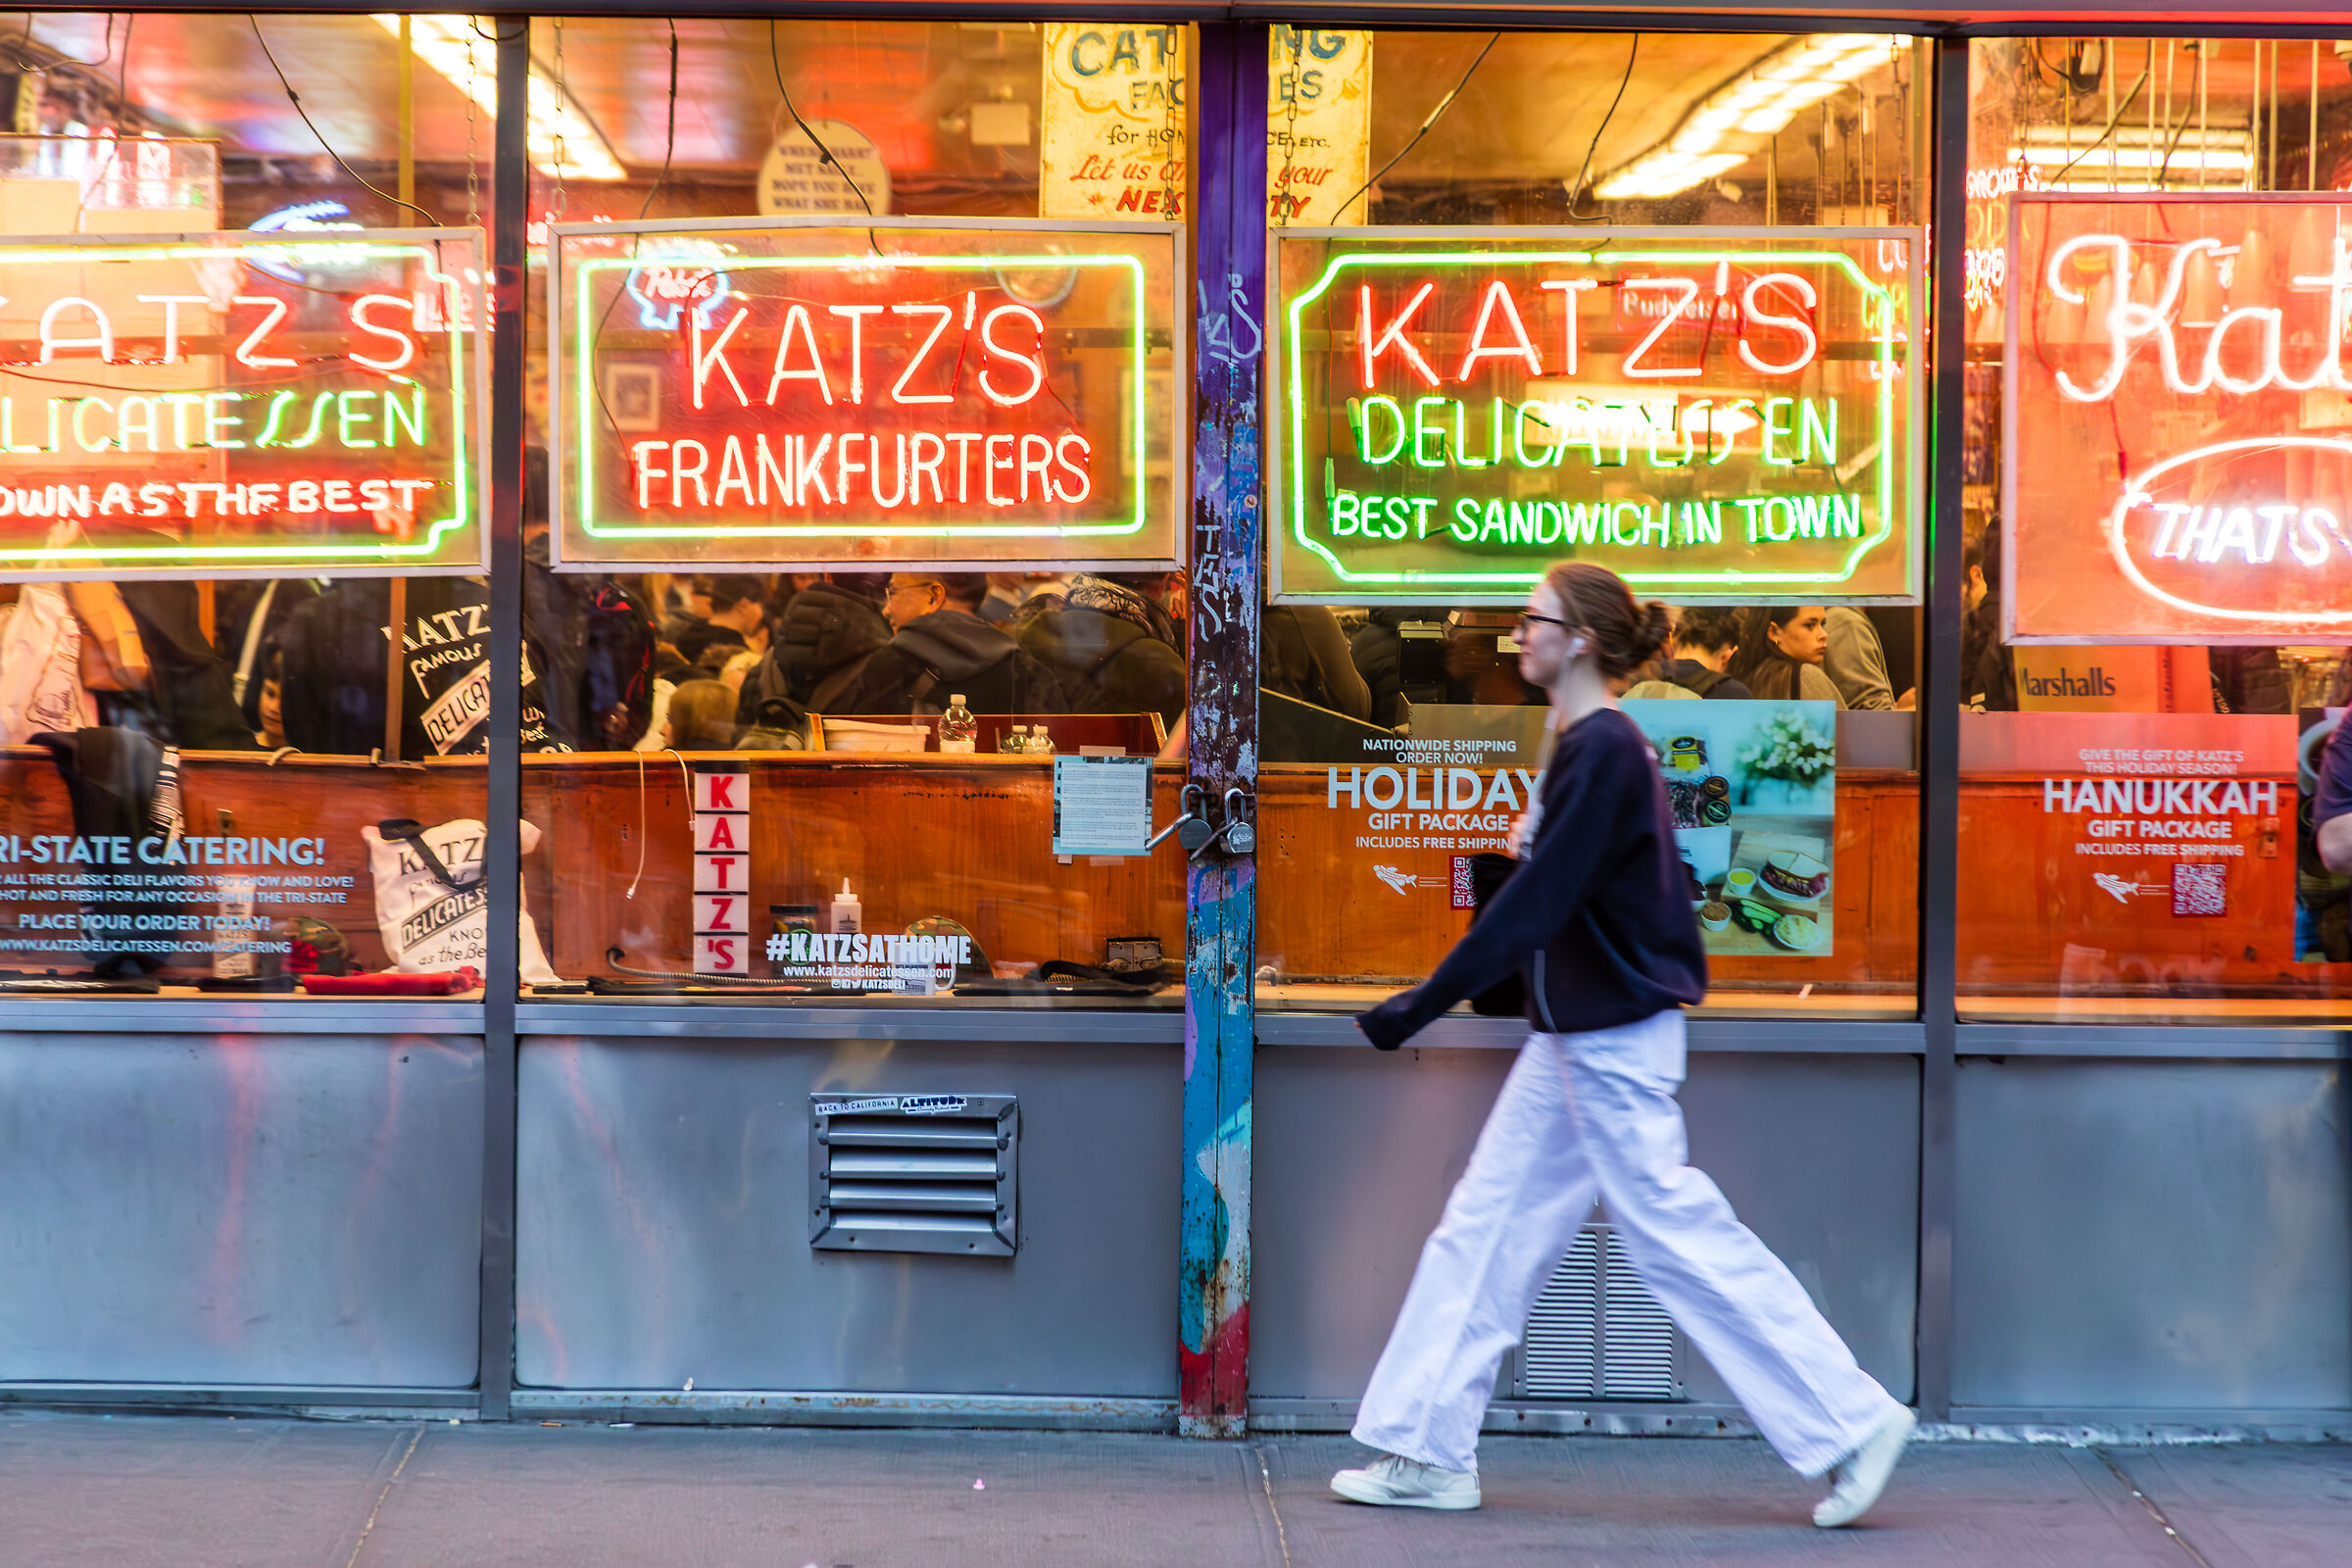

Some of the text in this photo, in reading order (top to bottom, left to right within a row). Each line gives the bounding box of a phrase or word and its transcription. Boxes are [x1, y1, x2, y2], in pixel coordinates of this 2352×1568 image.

[1107, 125, 1139, 145] for
[1070, 154, 1115, 181] Let
[1123, 162, 1152, 180] us
[1274, 166, 1334, 189] your
[1116, 186, 1185, 215] NEX
[0, 294, 414, 370] ATZS
[1359, 260, 1818, 389] KATZ'S
[690, 291, 1045, 409] KATZ'S
[1360, 395, 1838, 468] DELICATESSEN
[633, 432, 1092, 509] FRANKFURTERS
[288, 479, 434, 514] BEST
[1332, 493, 1861, 548] BEST SANDWICH IN TOWN
[1362, 739, 1517, 753] NATIONWIDE SHIPPING
[1396, 752, 1483, 764] ORDER NOW!
[2079, 749, 2244, 762] GIVE THE GIFT OF KATZ'S
[2085, 761, 2237, 774] THIS HOLIDAY SEASON!
[1328, 766, 1547, 811] HOLIDAY
[2043, 778, 2278, 815] HANUKKAH
[1368, 813, 1510, 831] GIFT PACKAGE
[2087, 819, 2232, 839] GIFT PACKAGE
[0, 835, 325, 866] RI-STATE CATERING!
[1356, 836, 1511, 850] INCLUDES FREE SHIPPIN
[2075, 843, 2244, 857] INCLUDES FREE SHIPPING
[398, 837, 483, 877] KTZ
[2, 873, 354, 889] ALL THE CLASSIC DELI FLAVORS YOU KNOW AND LOVE!
[709, 775, 736, 971] KATZ'S
[0, 889, 348, 904] HOT AND FRESH FOR ANY OCCASION IN THE TRI-STATE
[19, 913, 271, 931] PLACE YOUR ORDER TODAY!
[438, 947, 463, 963] the
[765, 933, 972, 964] #KATZSATHOME
[783, 964, 954, 978] www.katzsdelicatessen.com
[851, 1100, 896, 1109] CALIFORNIA
